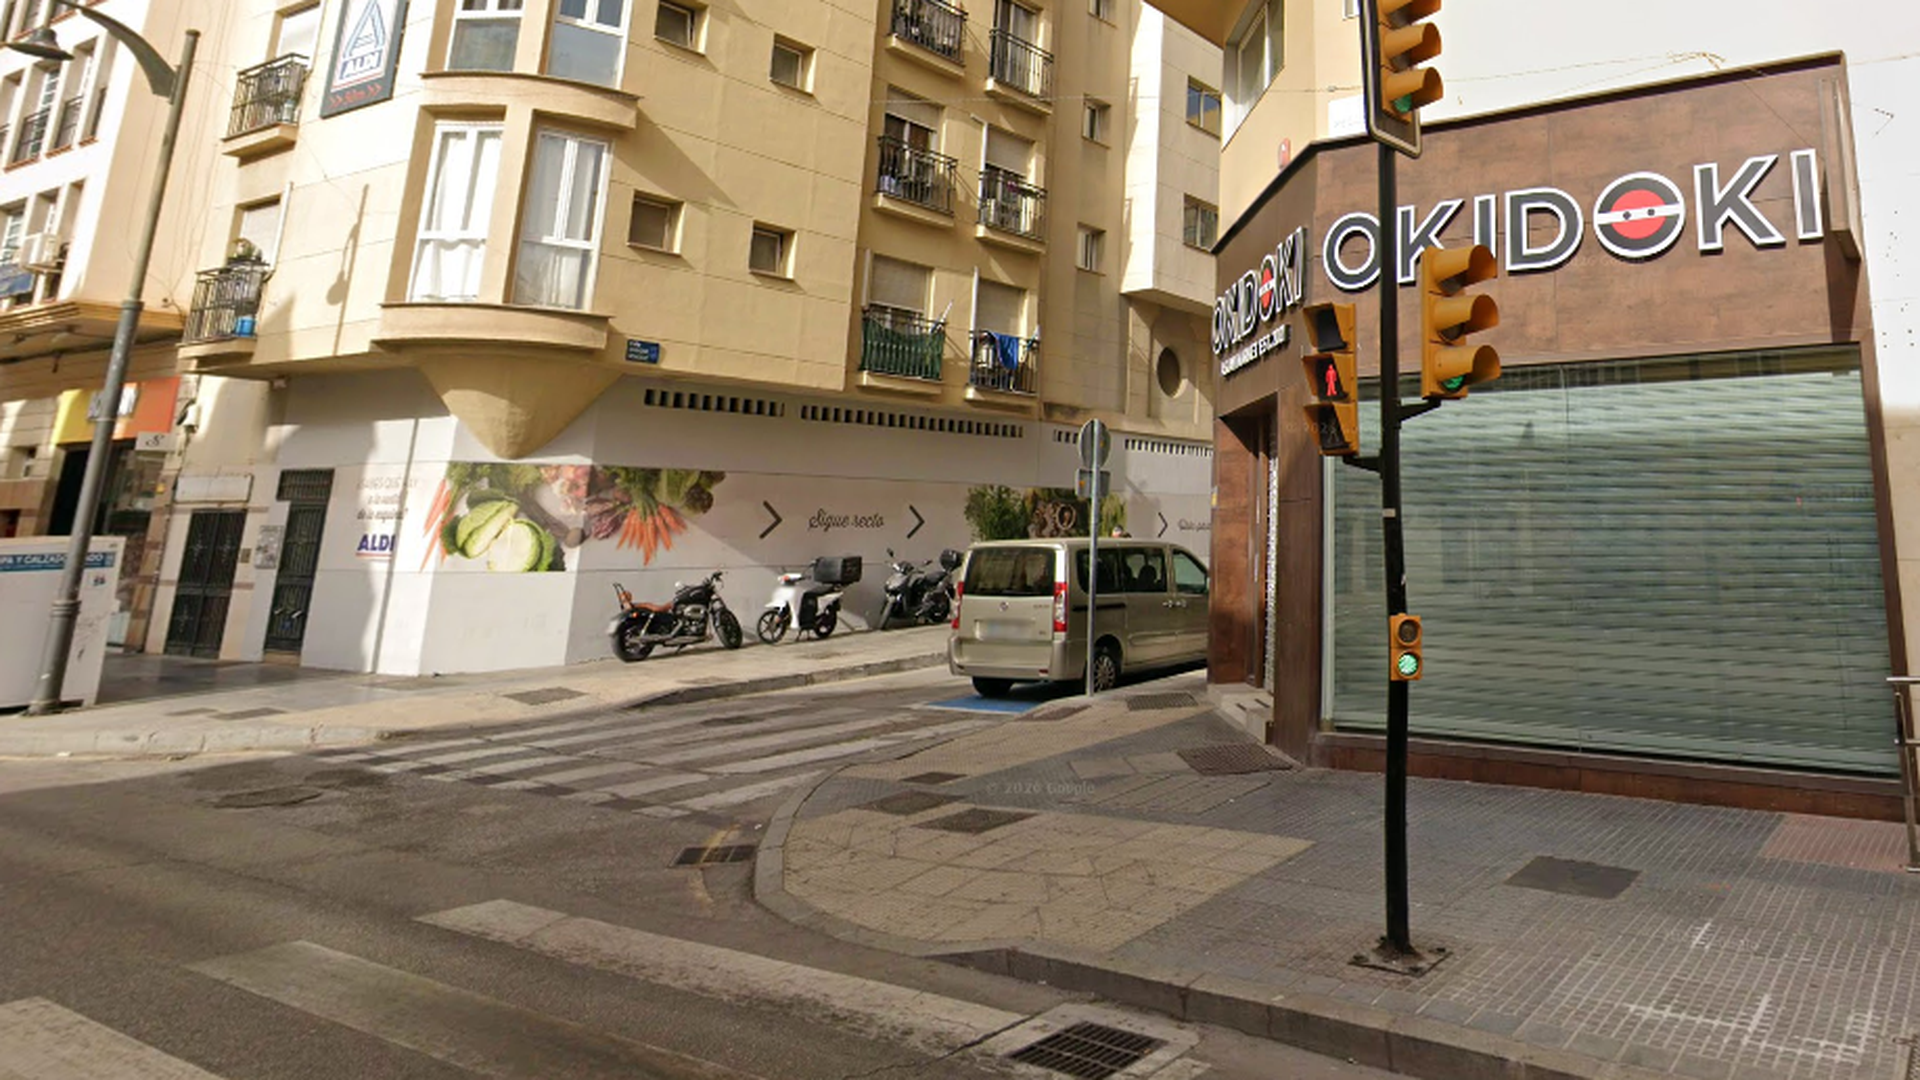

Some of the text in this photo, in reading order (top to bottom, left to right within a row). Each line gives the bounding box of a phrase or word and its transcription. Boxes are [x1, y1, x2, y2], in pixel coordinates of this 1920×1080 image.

[340, 50, 382, 79] ALDI
[1323, 149, 1823, 289] OKIDOKI
[807, 507, 884, 532] Sigue recto
[357, 533, 396, 552] ALDI
